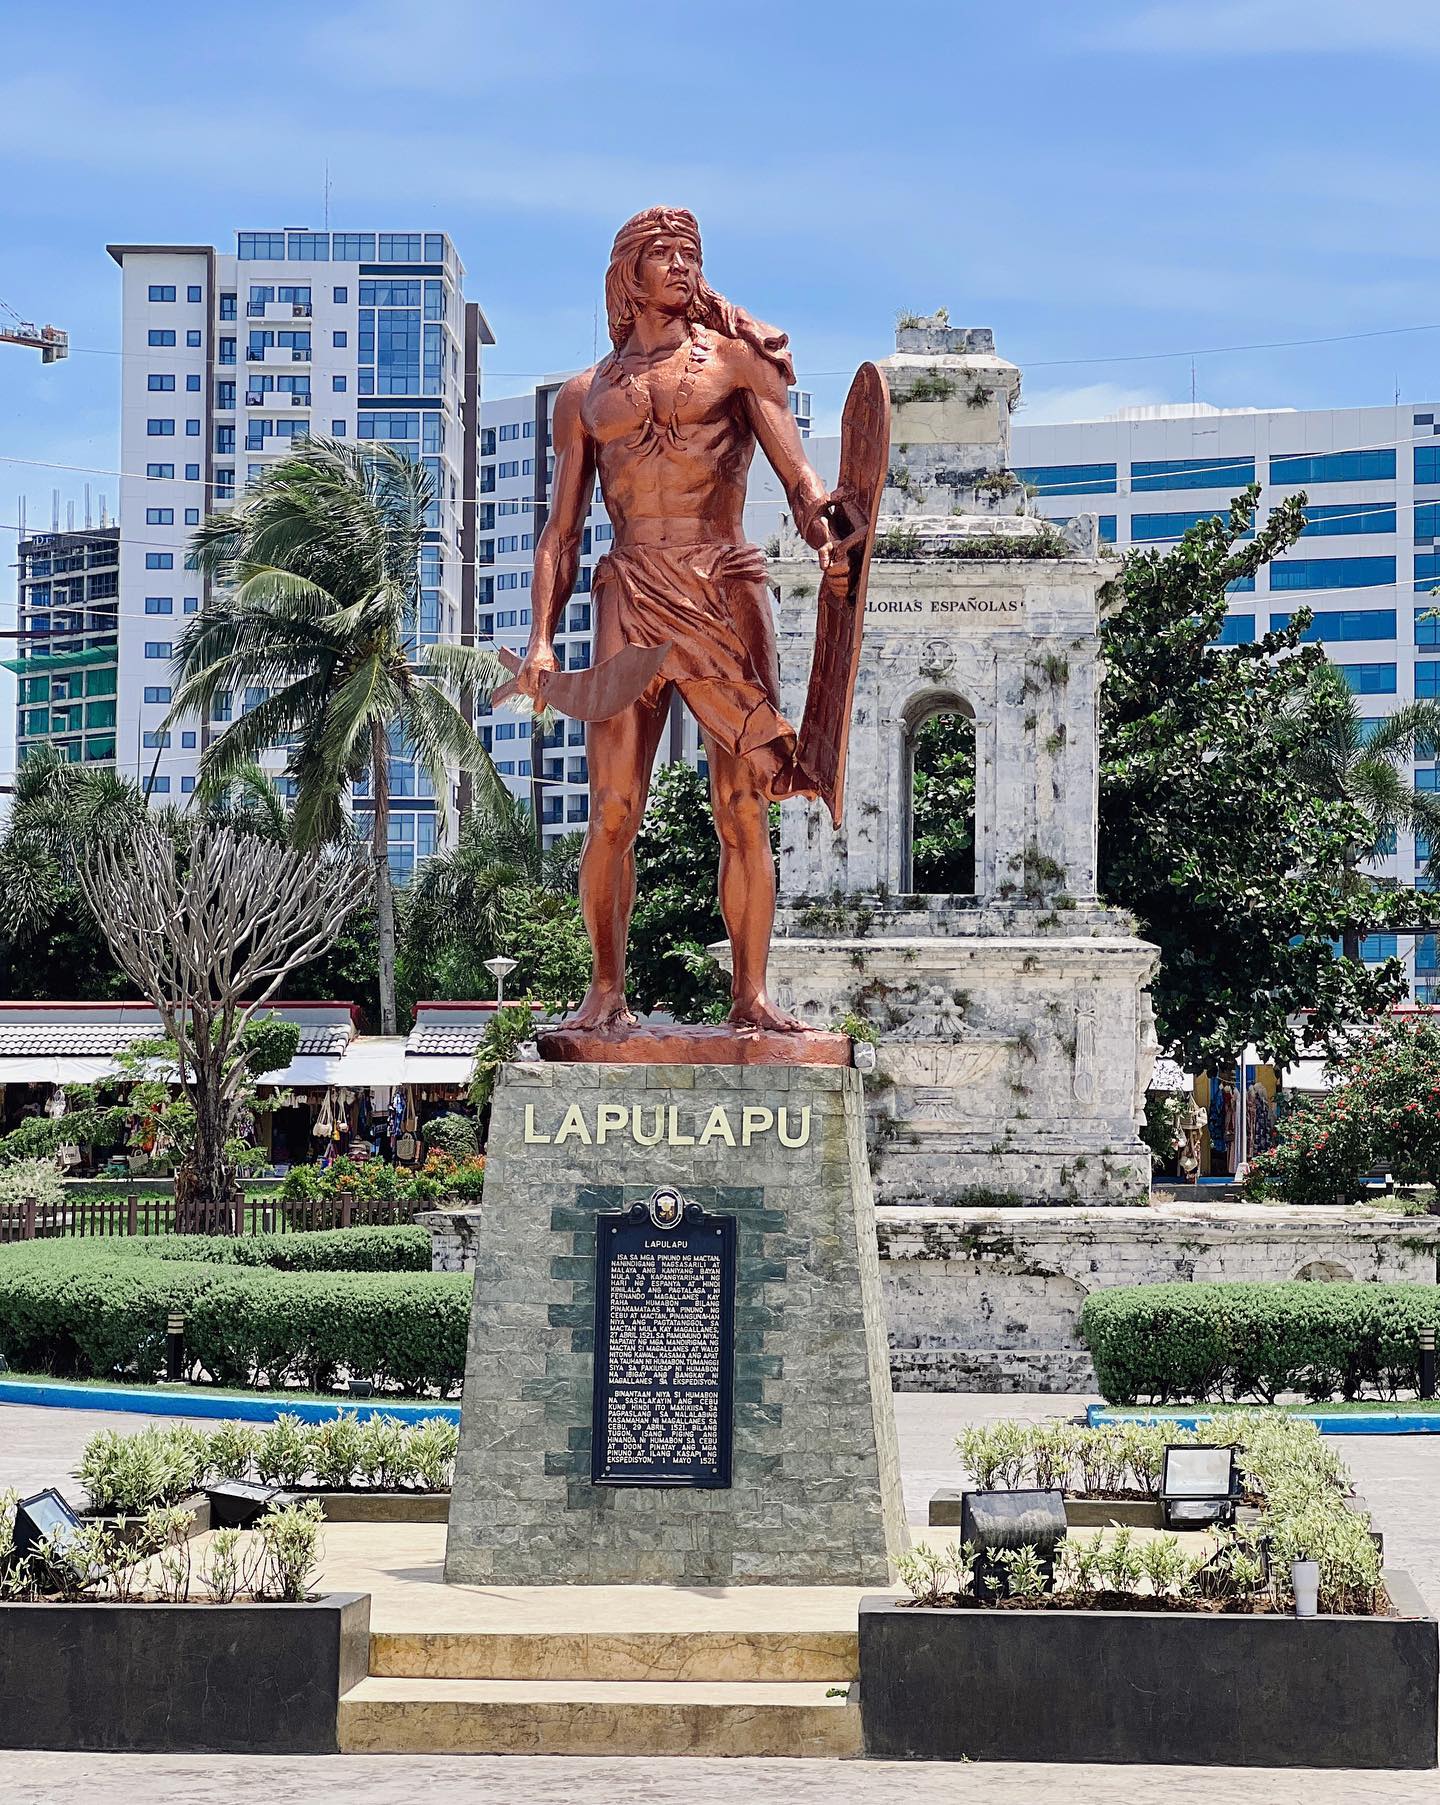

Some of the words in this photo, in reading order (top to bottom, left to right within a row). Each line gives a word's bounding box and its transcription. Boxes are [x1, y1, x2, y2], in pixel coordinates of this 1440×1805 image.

[864, 600, 923, 613] LORIAS
[524, 1103, 811, 1148] LAPULAPU
[644, 1240, 688, 1249] LAPULAPU
